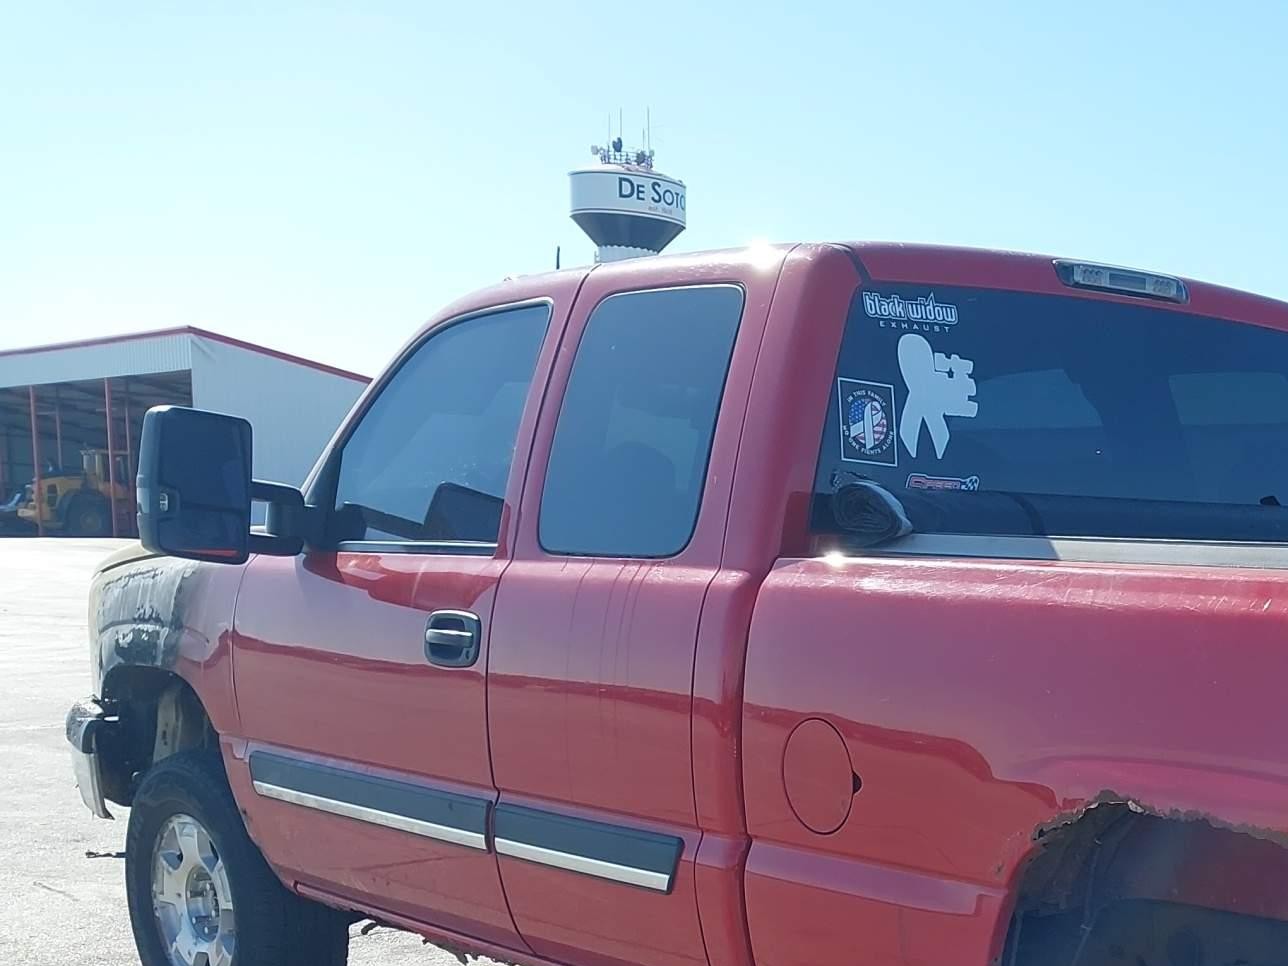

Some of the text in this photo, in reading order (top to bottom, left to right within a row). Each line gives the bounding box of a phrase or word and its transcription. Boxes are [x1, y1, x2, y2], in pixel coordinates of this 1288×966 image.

[864, 293, 957, 323] black widow
[879, 320, 951, 333] EXHAUST
[853, 389, 866, 397] THIS
